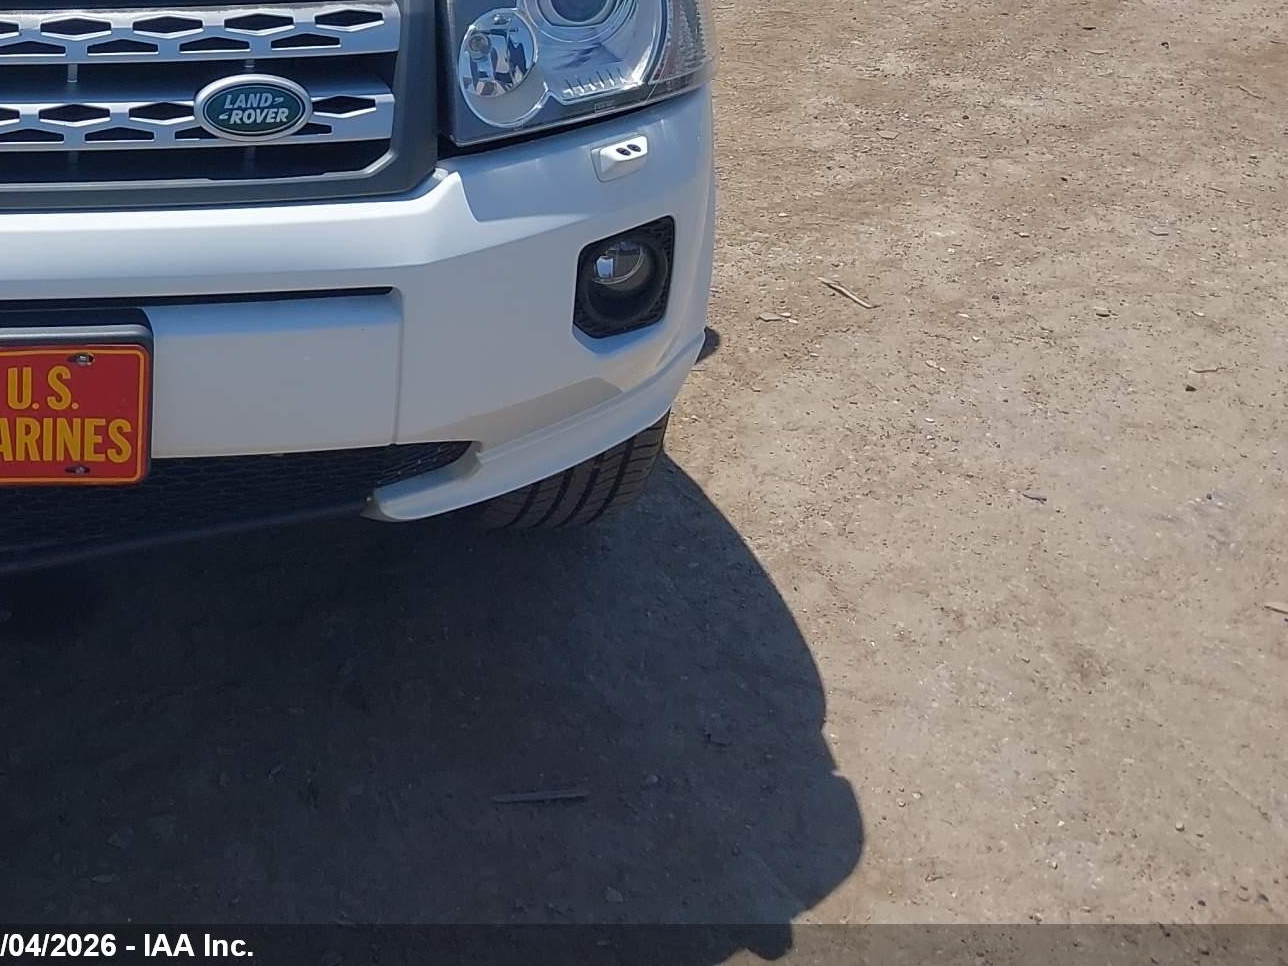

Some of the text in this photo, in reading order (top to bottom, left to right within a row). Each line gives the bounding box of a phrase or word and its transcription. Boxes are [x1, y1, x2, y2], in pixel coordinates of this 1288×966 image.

[224, 93, 272, 109] LAND
[230, 108, 289, 124] ROVER
[7, 365, 79, 410] U.S.
